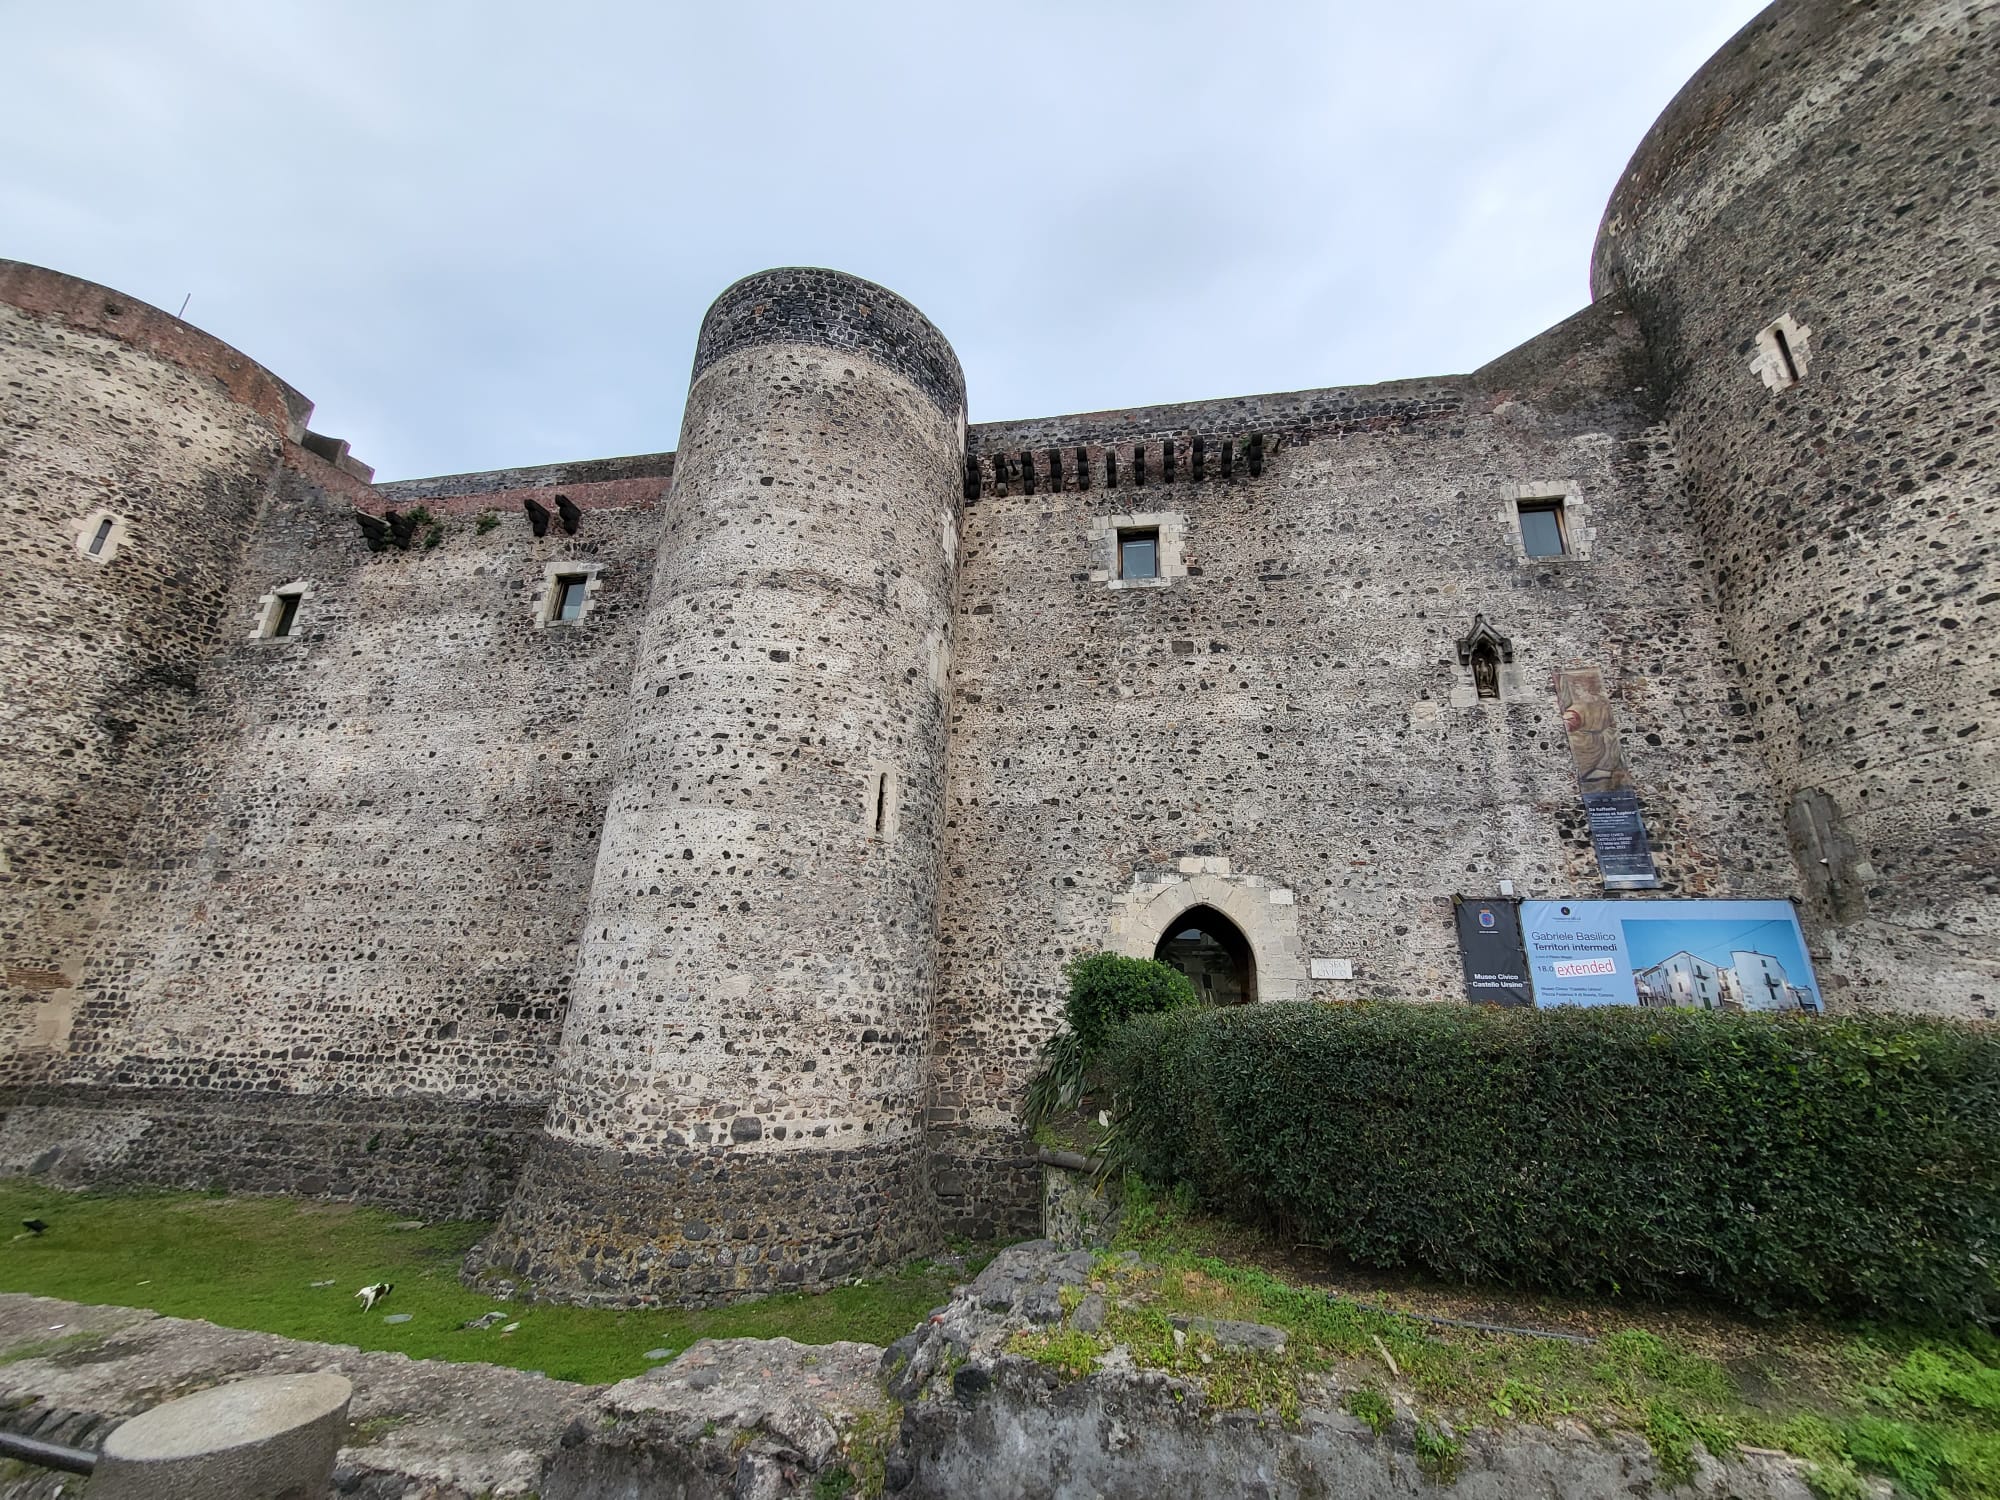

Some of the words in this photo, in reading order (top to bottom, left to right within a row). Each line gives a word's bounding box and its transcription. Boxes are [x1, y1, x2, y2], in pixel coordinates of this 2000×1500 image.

[1531, 931, 1574, 941] Gabriele
[1576, 931, 1616, 941] Basilico
[1533, 942, 1570, 951] Territori
[1572, 943, 1618, 952] intermedi
[1557, 959, 1614, 976] extended
